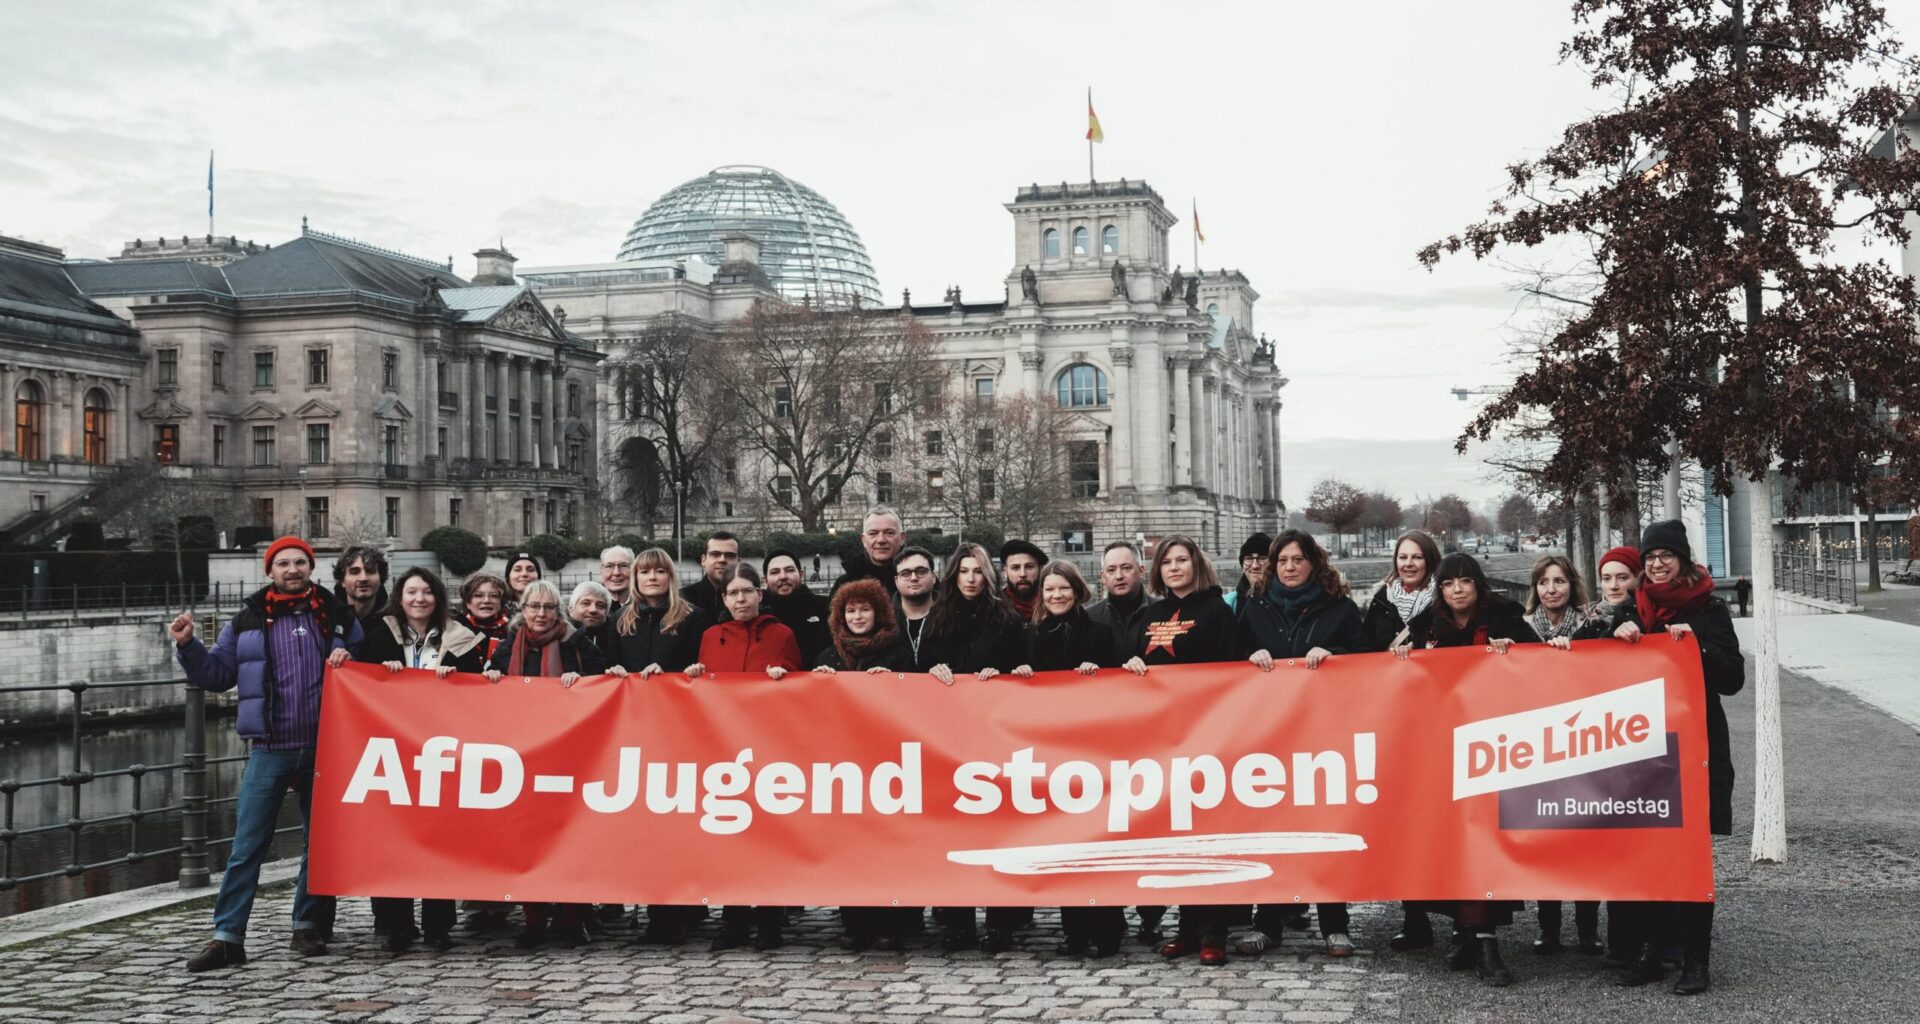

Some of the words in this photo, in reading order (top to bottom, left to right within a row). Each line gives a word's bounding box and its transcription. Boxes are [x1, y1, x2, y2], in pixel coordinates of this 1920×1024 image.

[1468, 734, 1534, 780] Die
[1543, 710, 1651, 764] Linke
[341, 735, 923, 835] AfD-Jugend
[953, 732, 1379, 833] stoppen!
[1537, 798, 1559, 816] Im
[1564, 796, 1670, 818] Bundestag
